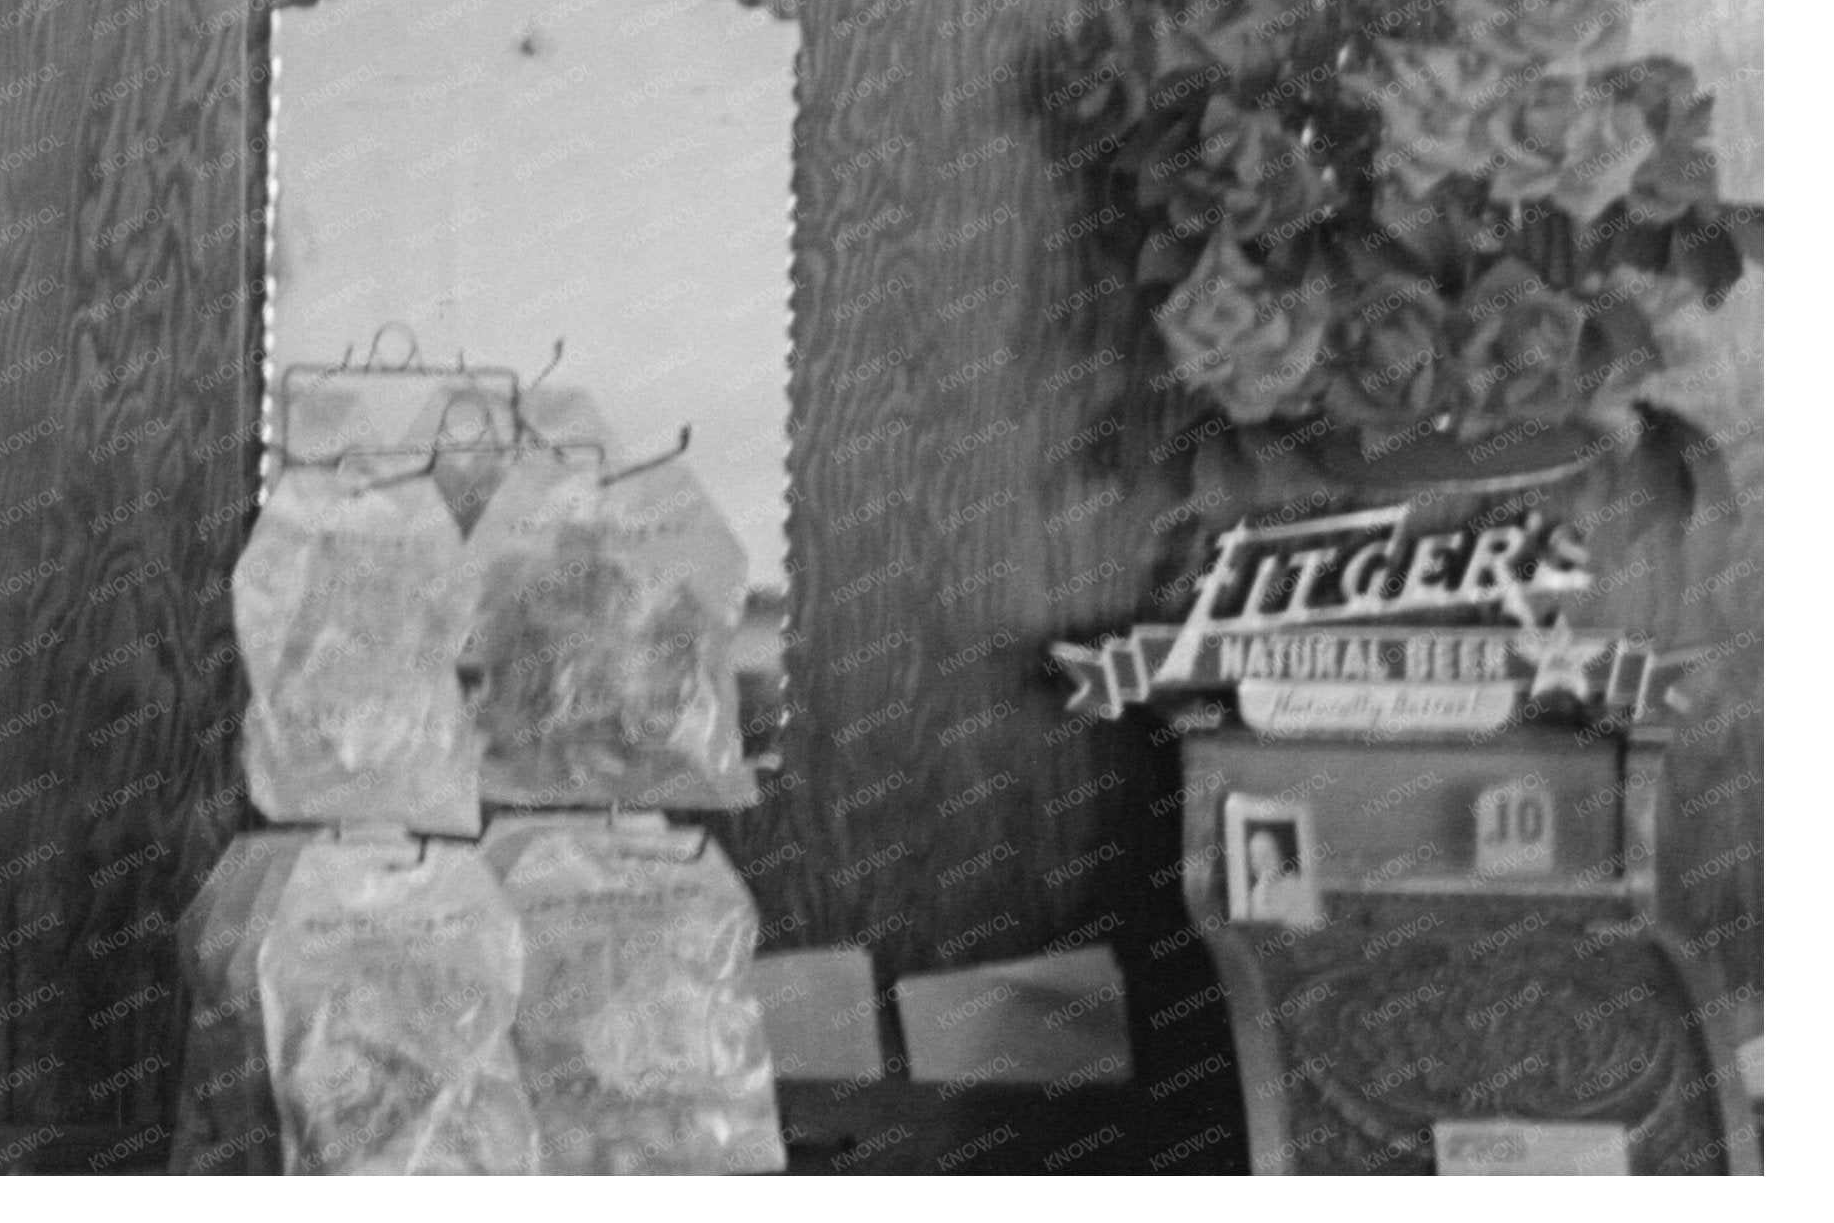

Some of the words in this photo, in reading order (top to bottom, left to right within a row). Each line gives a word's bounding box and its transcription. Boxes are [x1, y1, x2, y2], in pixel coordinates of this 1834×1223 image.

[1218, 635, 1390, 680] NATURAL
[1404, 635, 1509, 681] BEER
[1483, 797, 1545, 846] 10
